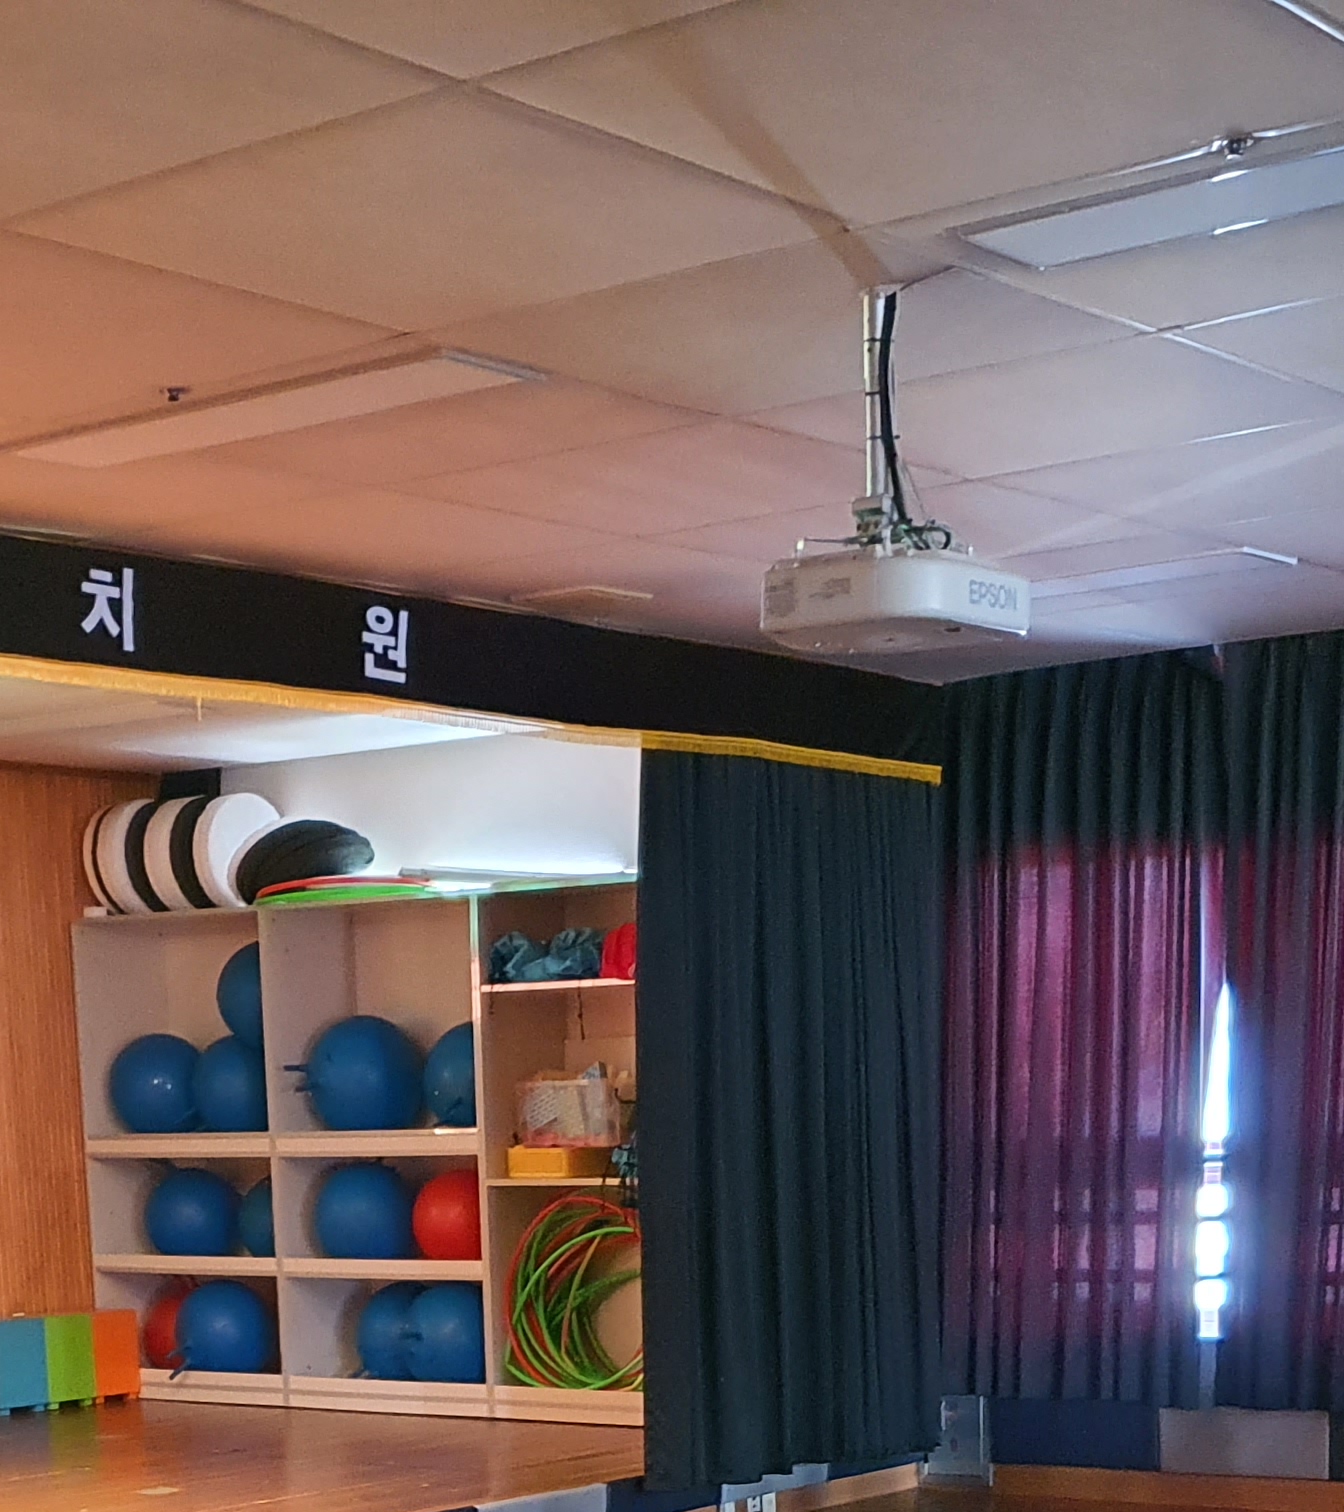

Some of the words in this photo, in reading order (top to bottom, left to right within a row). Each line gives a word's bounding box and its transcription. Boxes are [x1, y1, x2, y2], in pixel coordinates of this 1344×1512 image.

[80, 567, 136, 652] 치
[361, 604, 409, 684] 원
[968, 579, 1017, 611] EPSON
